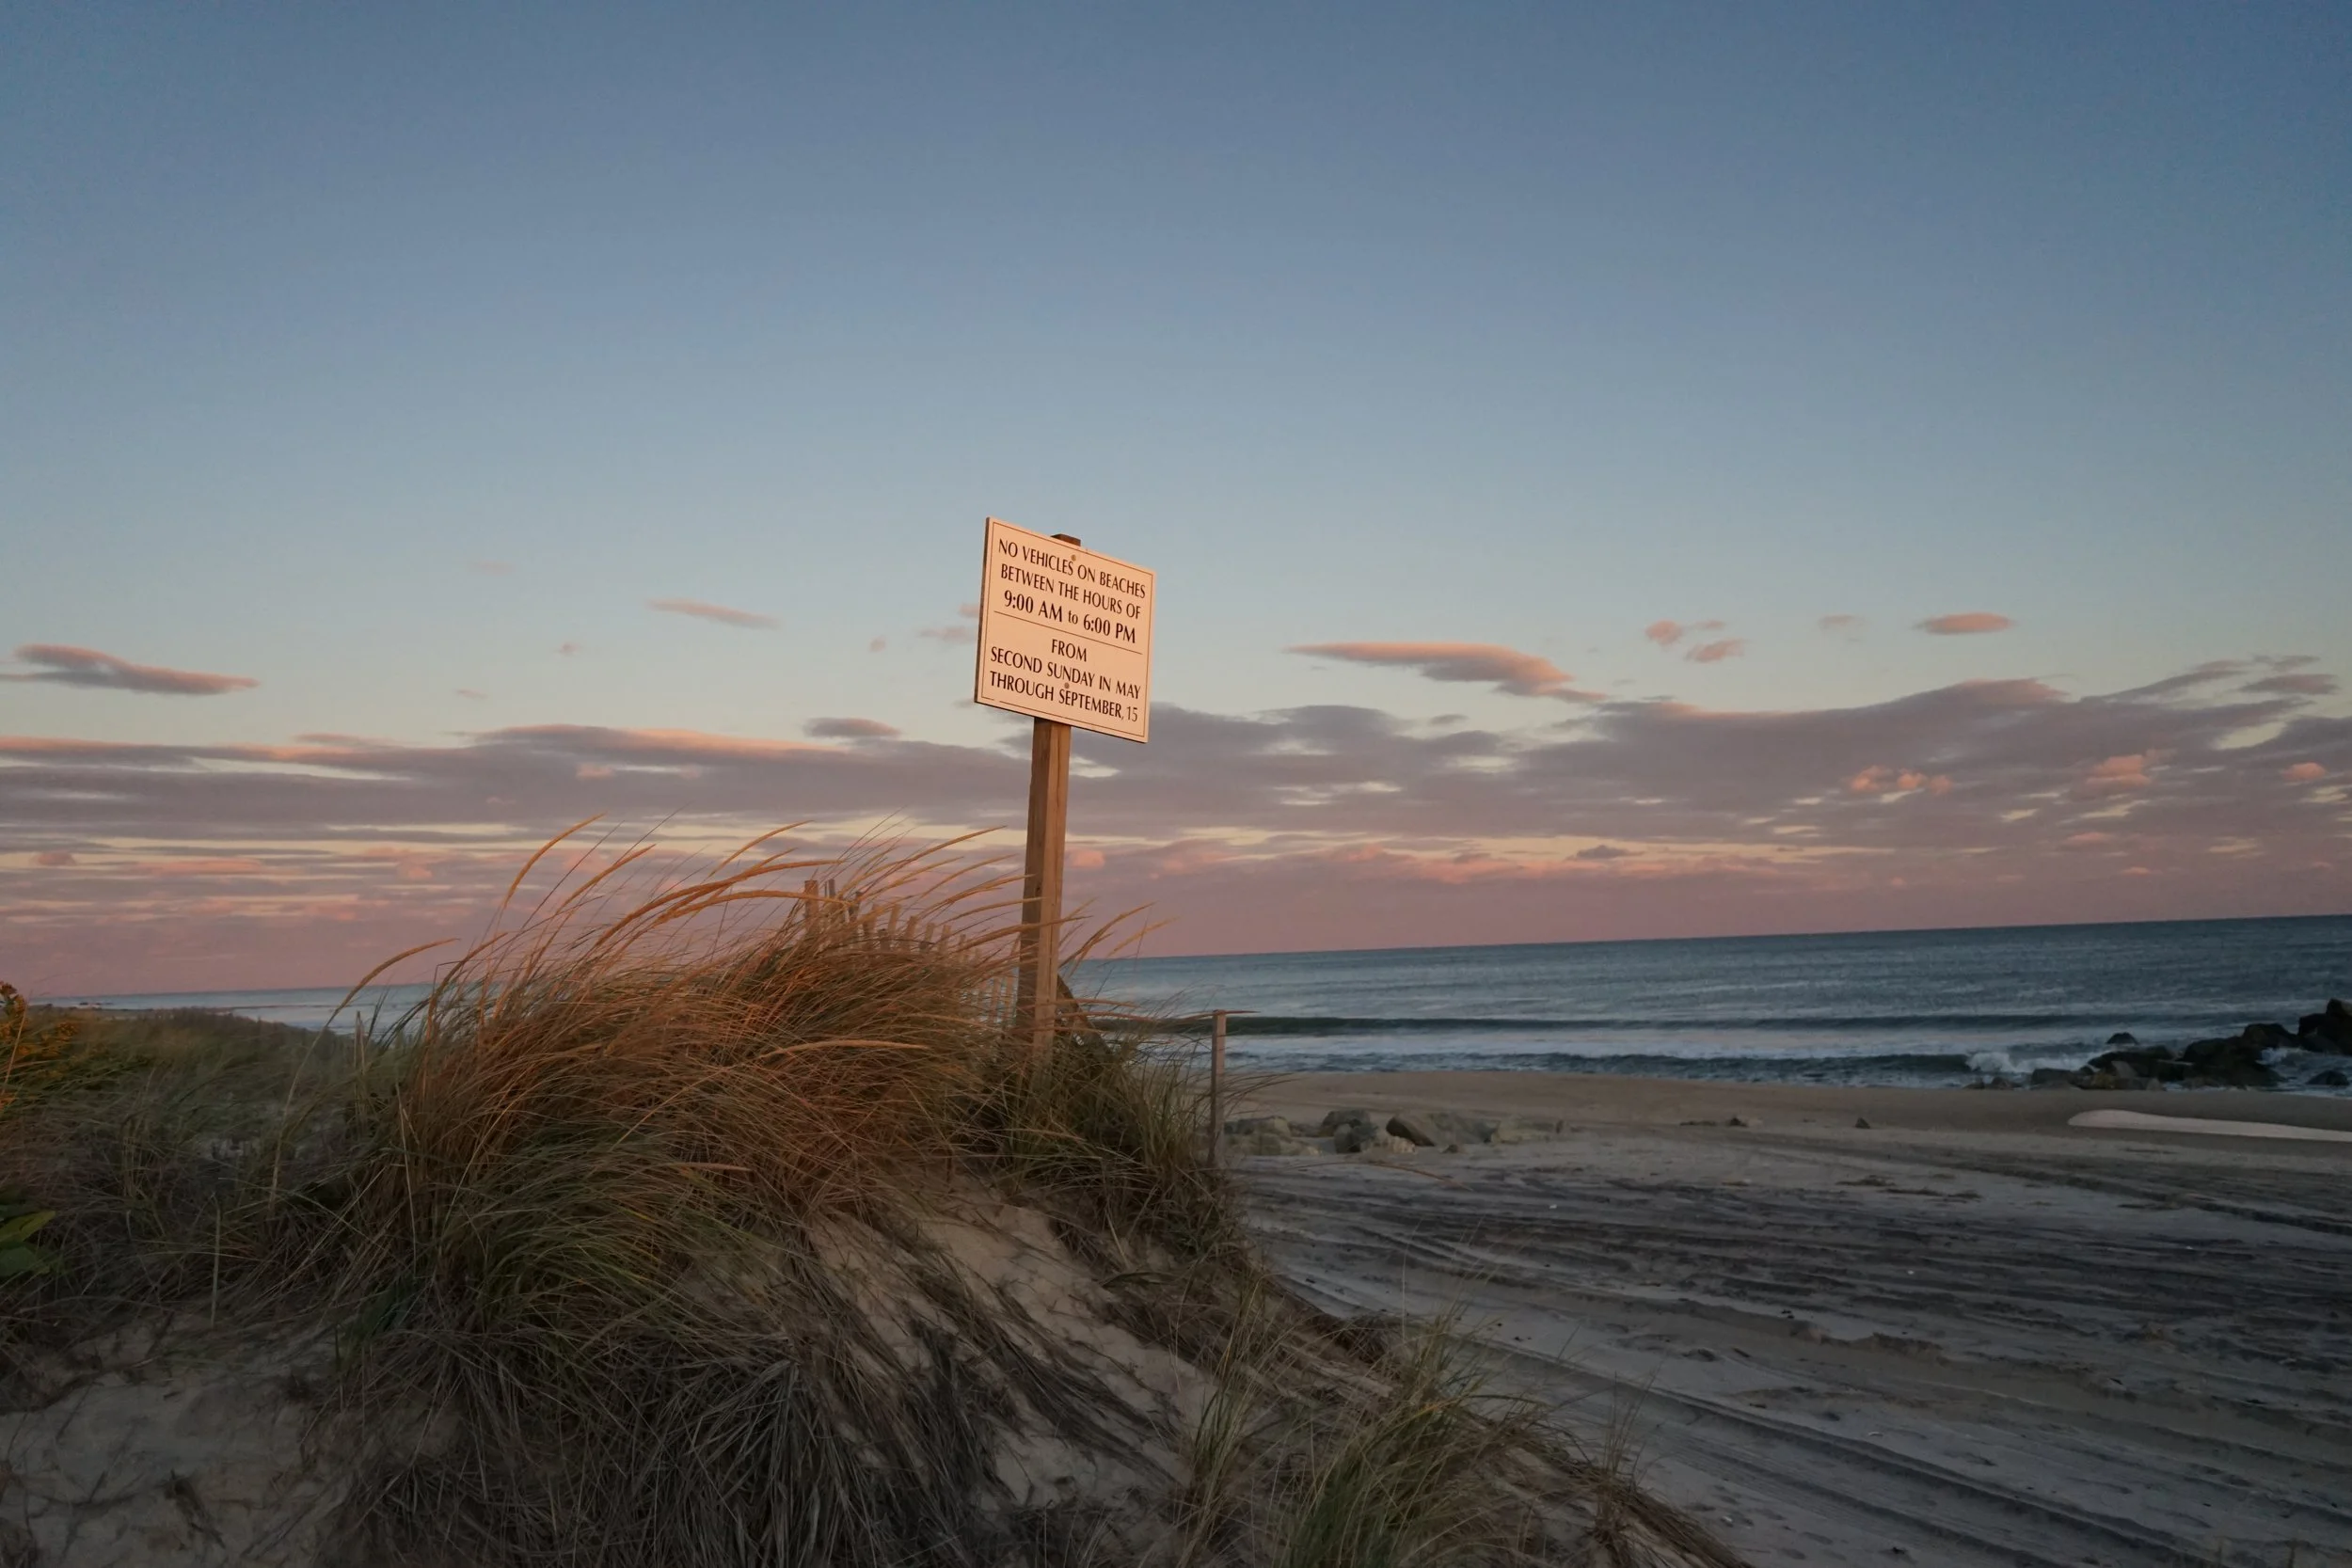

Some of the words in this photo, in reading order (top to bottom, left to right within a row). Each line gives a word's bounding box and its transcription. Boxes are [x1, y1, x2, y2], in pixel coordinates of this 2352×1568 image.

[998, 538, 1018, 558] NO
[1022, 545, 1074, 576] VEHICLES
[1077, 564, 1096, 583] ON
[1099, 571, 1146, 598] BEACHES
[1000, 563, 1055, 593] BETWEEN
[1058, 580, 1079, 601] THE
[1083, 589, 1122, 614] HOURS
[1126, 603, 1141, 620] OF
[1004, 590, 1034, 613] 9:00
[1038, 600, 1062, 623] AM
[1068, 610, 1079, 625] to
[1083, 613, 1110, 636] 6:00
[1115, 623, 1136, 643] PM
[990, 646, 1042, 673] SECOND
[1047, 661, 1096, 688] SUNDAY
[1099, 675, 1112, 692] IN
[1115, 682, 1141, 700] MAY
[1051, 639, 1087, 662] FROM
[990, 671, 1054, 702] THROUGH
[1058, 689, 1124, 721] SEPTEMBER,
[1126, 706, 1138, 722] 15
